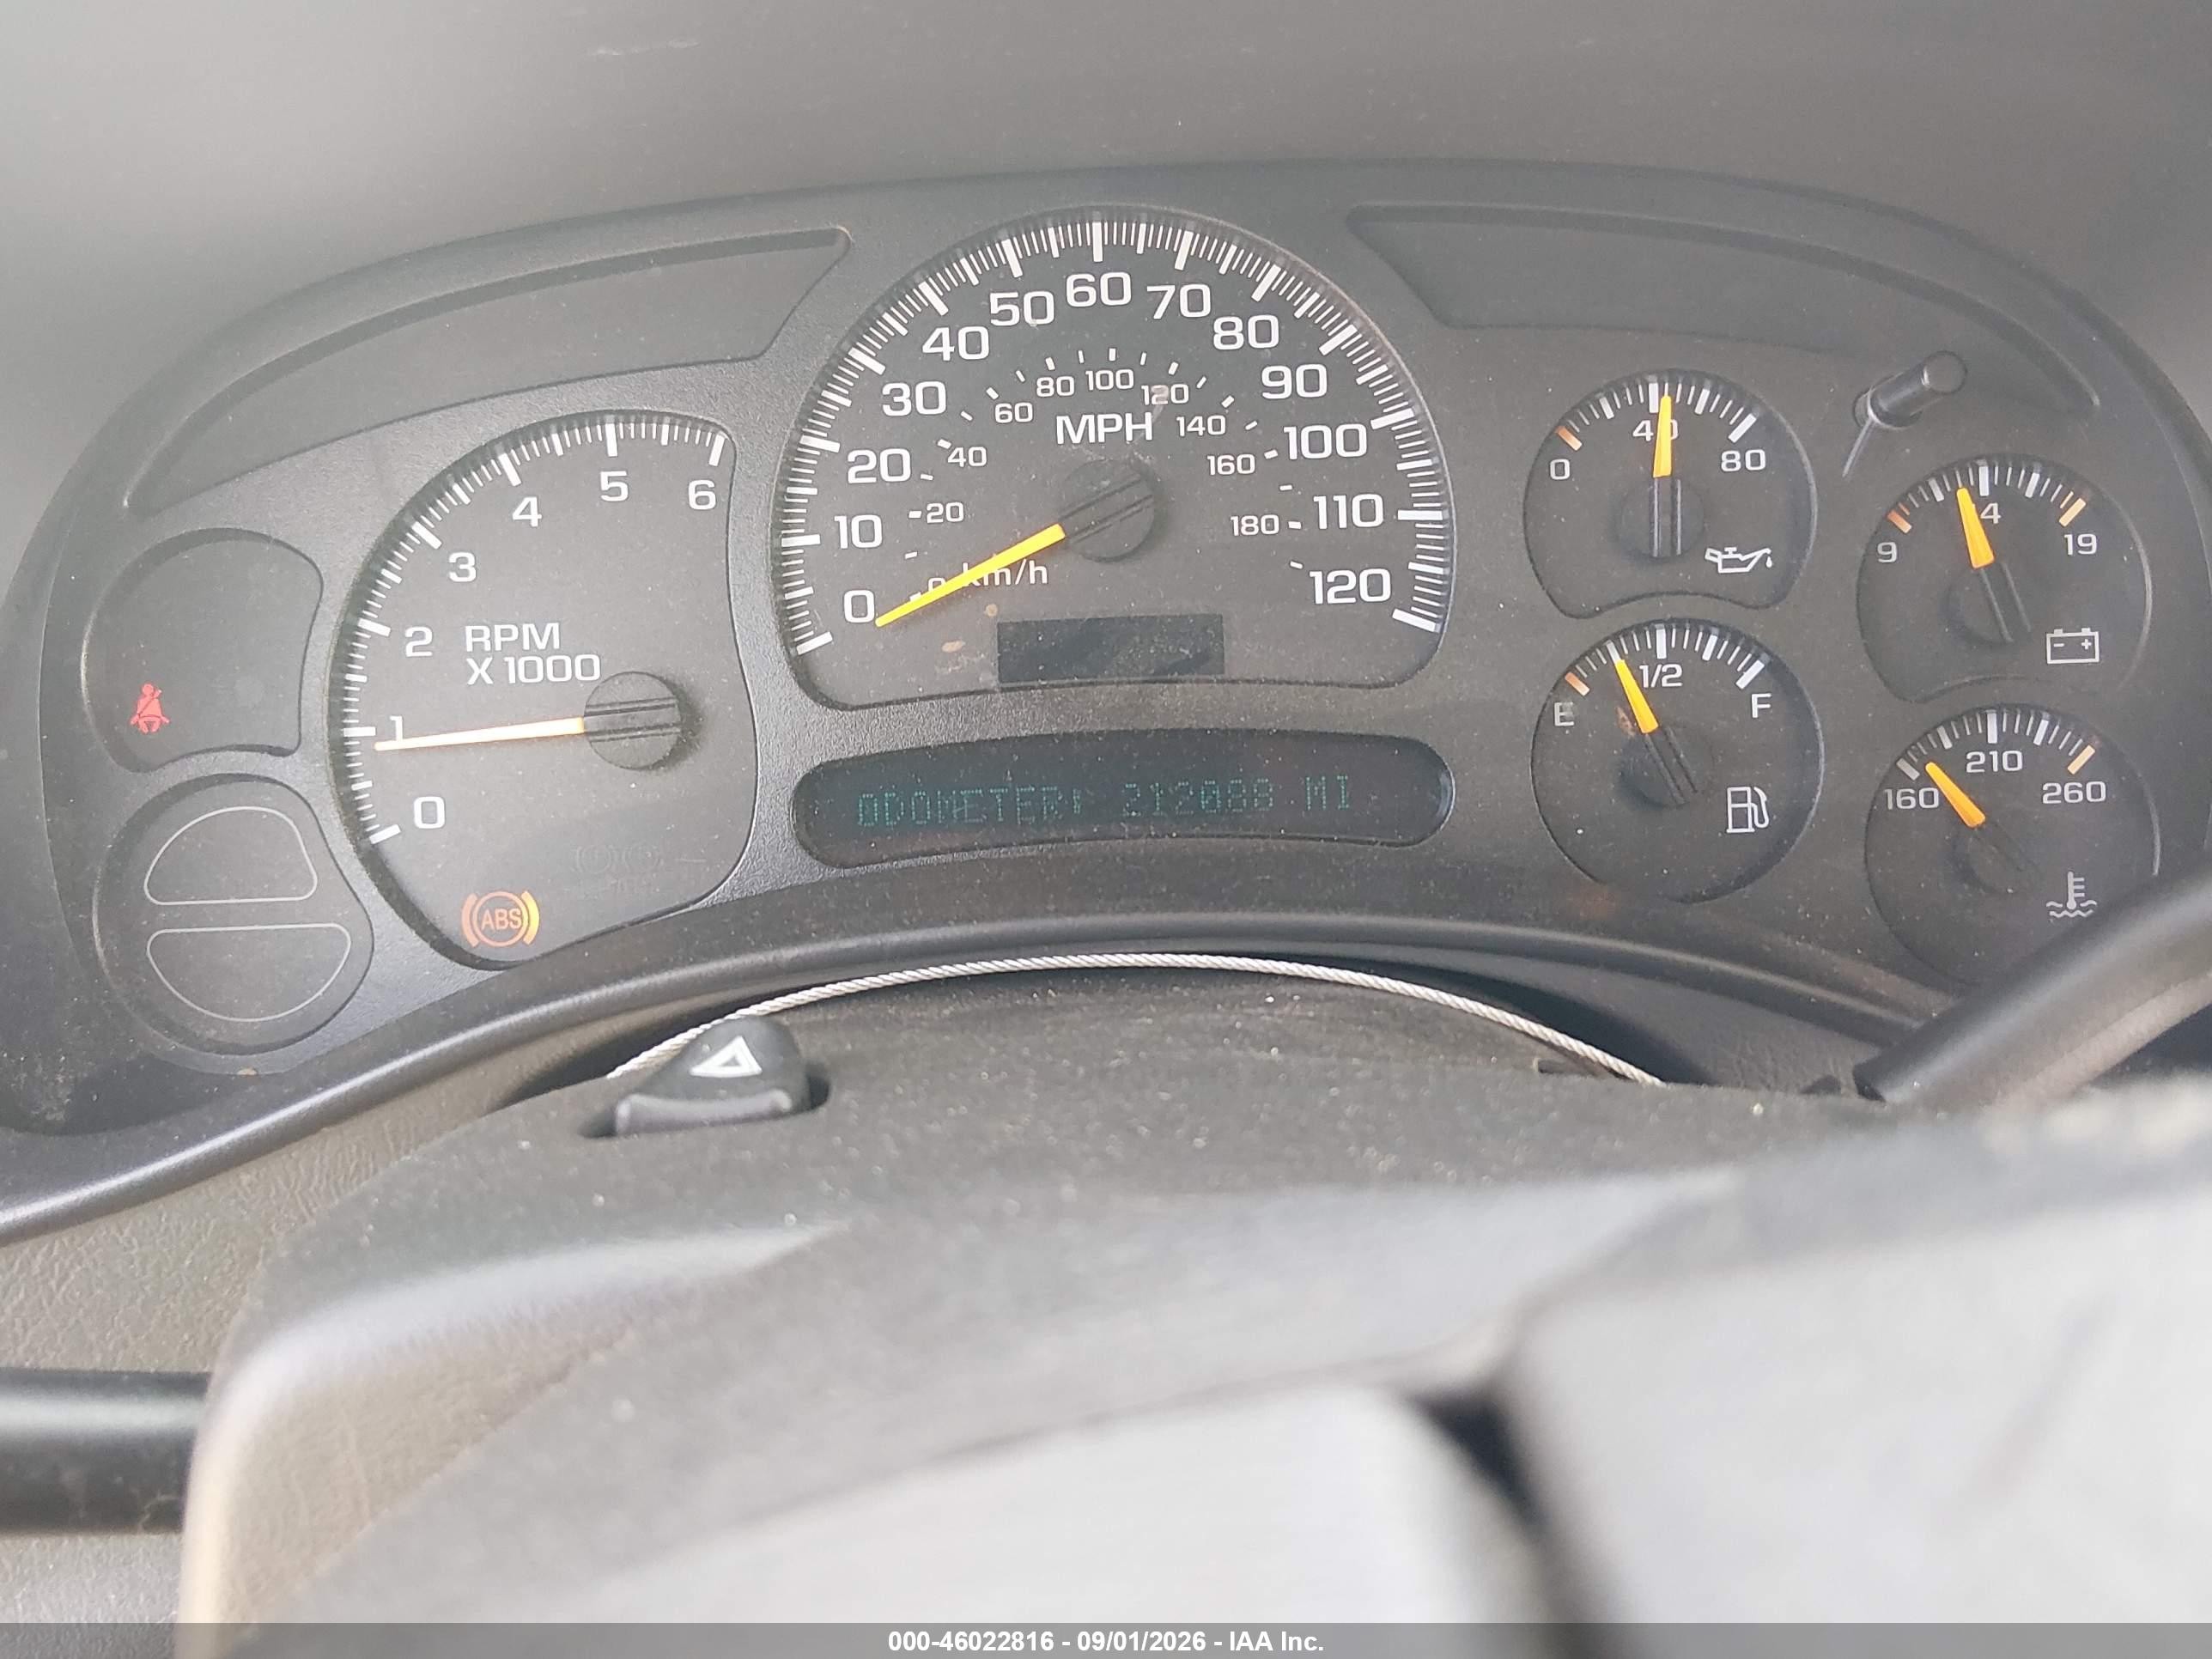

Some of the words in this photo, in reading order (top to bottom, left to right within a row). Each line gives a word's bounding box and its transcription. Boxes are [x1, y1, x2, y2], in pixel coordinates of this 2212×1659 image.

[1066, 271, 1132, 307] 60
[1146, 283, 1211, 319] 70
[989, 290, 1054, 326] 50
[921, 325, 990, 362] 40
[1213, 314, 1279, 350] 80
[1036, 375, 1075, 398] 80
[1085, 368, 1134, 391] 100
[1140, 383, 1189, 405] 120
[1261, 363, 1328, 399] 90
[882, 380, 946, 416] 30
[994, 402, 1033, 423] 60
[1056, 411, 1152, 445] MPH
[1176, 415, 1226, 437] 140
[947, 445, 988, 468] 40
[1283, 423, 1367, 460] 100
[848, 448, 911, 484] 20
[1206, 453, 1255, 476] 160
[1550, 459, 1571, 480] 0
[1721, 449, 1766, 472] 80
[599, 471, 629, 501] 5
[688, 479, 716, 510] 6
[512, 496, 543, 527] 4
[927, 501, 964, 524] 20
[1230, 514, 1279, 537] 180
[1313, 493, 1384, 530] 110
[834, 514, 883, 550] 10
[2063, 533, 2097, 556] 19
[448, 551, 477, 582] 3
[1877, 542, 1898, 563] 9
[1309, 568, 1391, 605] 120
[843, 589, 875, 623] 0
[404, 626, 433, 657] 2
[465, 622, 560, 653] RPM
[465, 656, 494, 685] X
[503, 653, 600, 684] 1000
[1638, 664, 1683, 688] 1/2
[1554, 702, 1575, 726] E
[1751, 693, 1771, 719] F
[387, 714, 404, 743] 1
[1966, 750, 2023, 773] 210
[1304, 773, 1351, 811] MI
[1885, 787, 1940, 810] 160
[2042, 781, 2106, 805] 260
[413, 796, 446, 830] 0
[479, 908, 523, 931] ABS
